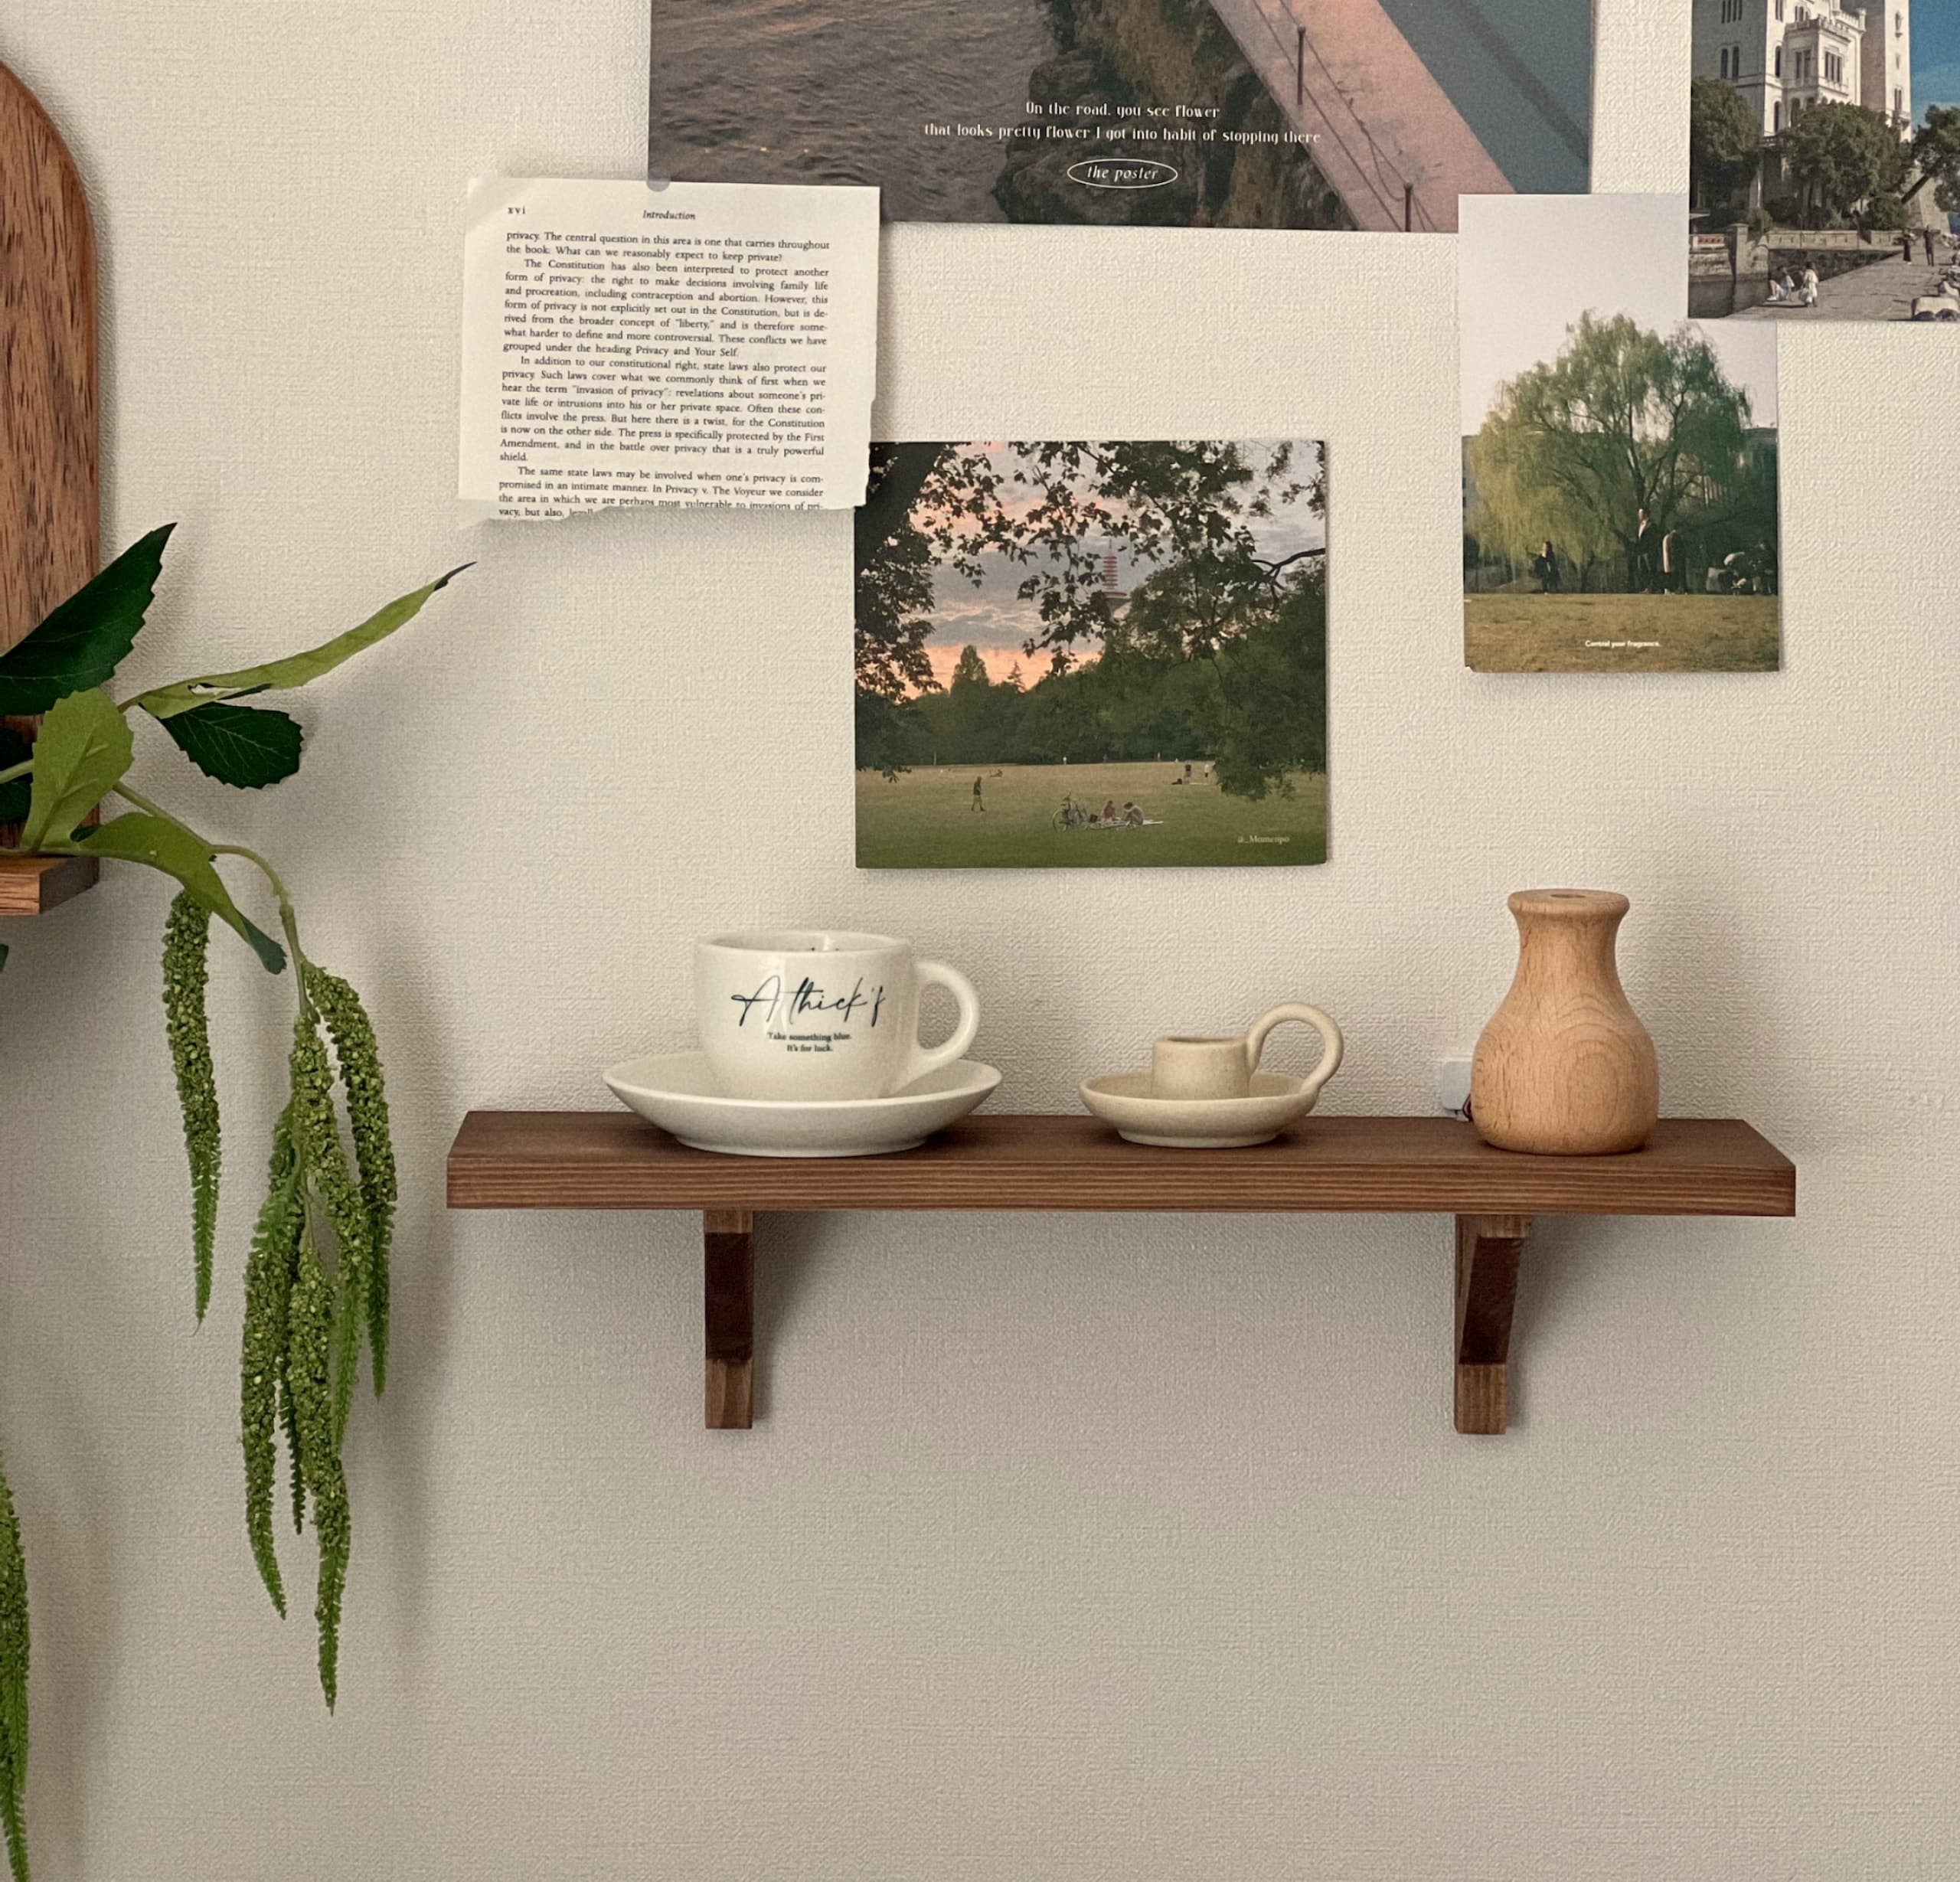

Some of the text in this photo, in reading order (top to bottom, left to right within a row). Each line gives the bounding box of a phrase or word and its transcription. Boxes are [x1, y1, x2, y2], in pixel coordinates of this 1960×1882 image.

[1026, 102, 1043, 115] On
[1049, 103, 1070, 116] the
[1116, 106, 1141, 119] you
[1146, 108, 1170, 117] see
[1175, 104, 1220, 118] flower
[925, 123, 951, 136] that
[957, 123, 993, 137] looks
[998, 126, 1041, 142] pretty
[1046, 126, 1090, 139] flower
[1106, 128, 1126, 142] got
[1132, 128, 1158, 141] into
[1164, 129, 1197, 142] habit
[1202, 129, 1217, 142] of
[1223, 130, 1279, 145] stopping
[1284, 131, 1321, 145] there
[1086, 164, 1159, 182] the poster
[642, 209, 696, 220] Introduction
[565, 233, 596, 242] central
[599, 234, 639, 244] question
[653, 234, 670, 244] this
[724, 237, 743, 247] that
[745, 239, 776, 247] carries
[778, 239, 830, 251] throughout
[555, 245, 782, 263] What reasonably expect keep private?
[548, 259, 829, 277] Constitution also been interpreted protect another
[505, 270, 528, 281] form
[612, 275, 634, 286] right
[655, 276, 680, 286] make
[686, 277, 727, 287] decisions
[732, 279, 775, 292] involving
[780, 279, 808, 292] family
[815, 280, 828, 290] life
[585, 288, 628, 300] including
[631, 291, 694, 302] contraception
[812, 294, 828, 303] this
[505, 299, 528, 309] form
[544, 302, 577, 312] privacy
[610, 302, 651, 315] explicitly
[504, 313, 795, 331] rived from broader concept therefore
[504, 327, 526, 336] what
[529, 328, 560, 338] harder
[575, 328, 603, 338] define
[718, 333, 745, 343] These
[749, 334, 786, 344] conflicts
[806, 335, 827, 345] have
[502, 341, 717, 357] grouped under heading Privacy Your
[534, 355, 806, 374] addition constitutional state laws also protect
[541, 369, 564, 379] Such
[567, 370, 587, 380] laws
[620, 371, 643, 381] what
[665, 374, 714, 386] commonly
[719, 374, 743, 384] think
[761, 375, 779, 385] first
[783, 376, 808, 386] when
[501, 382, 523, 392] hear
[545, 384, 568, 393] term
[675, 388, 724, 397] revelations
[728, 389, 754, 398] about
[501, 396, 802, 413] vate life intrusions into private Often these
[501, 409, 825, 427] flicts involve here there Constitution
[566, 426, 825, 442] other press specifically protected First
[619, 441, 645, 451] battle
[674, 444, 707, 454] privacy
[712, 443, 730, 453] that
[756, 445, 779, 457] truly
[783, 446, 825, 457] powerful
[592, 467, 612, 477] laws
[655, 470, 693, 480] involved
[697, 471, 722, 481] when
[753, 474, 786, 485] privacy
[498, 480, 541, 490] promised
[665, 484, 698, 496] Privacy
[733, 486, 766, 497] Voyeur
[785, 487, 824, 496] consider
[524, 507, 541, 516] but
[789, 1033, 831, 1042] something
[800, 1044, 812, 1052] for
